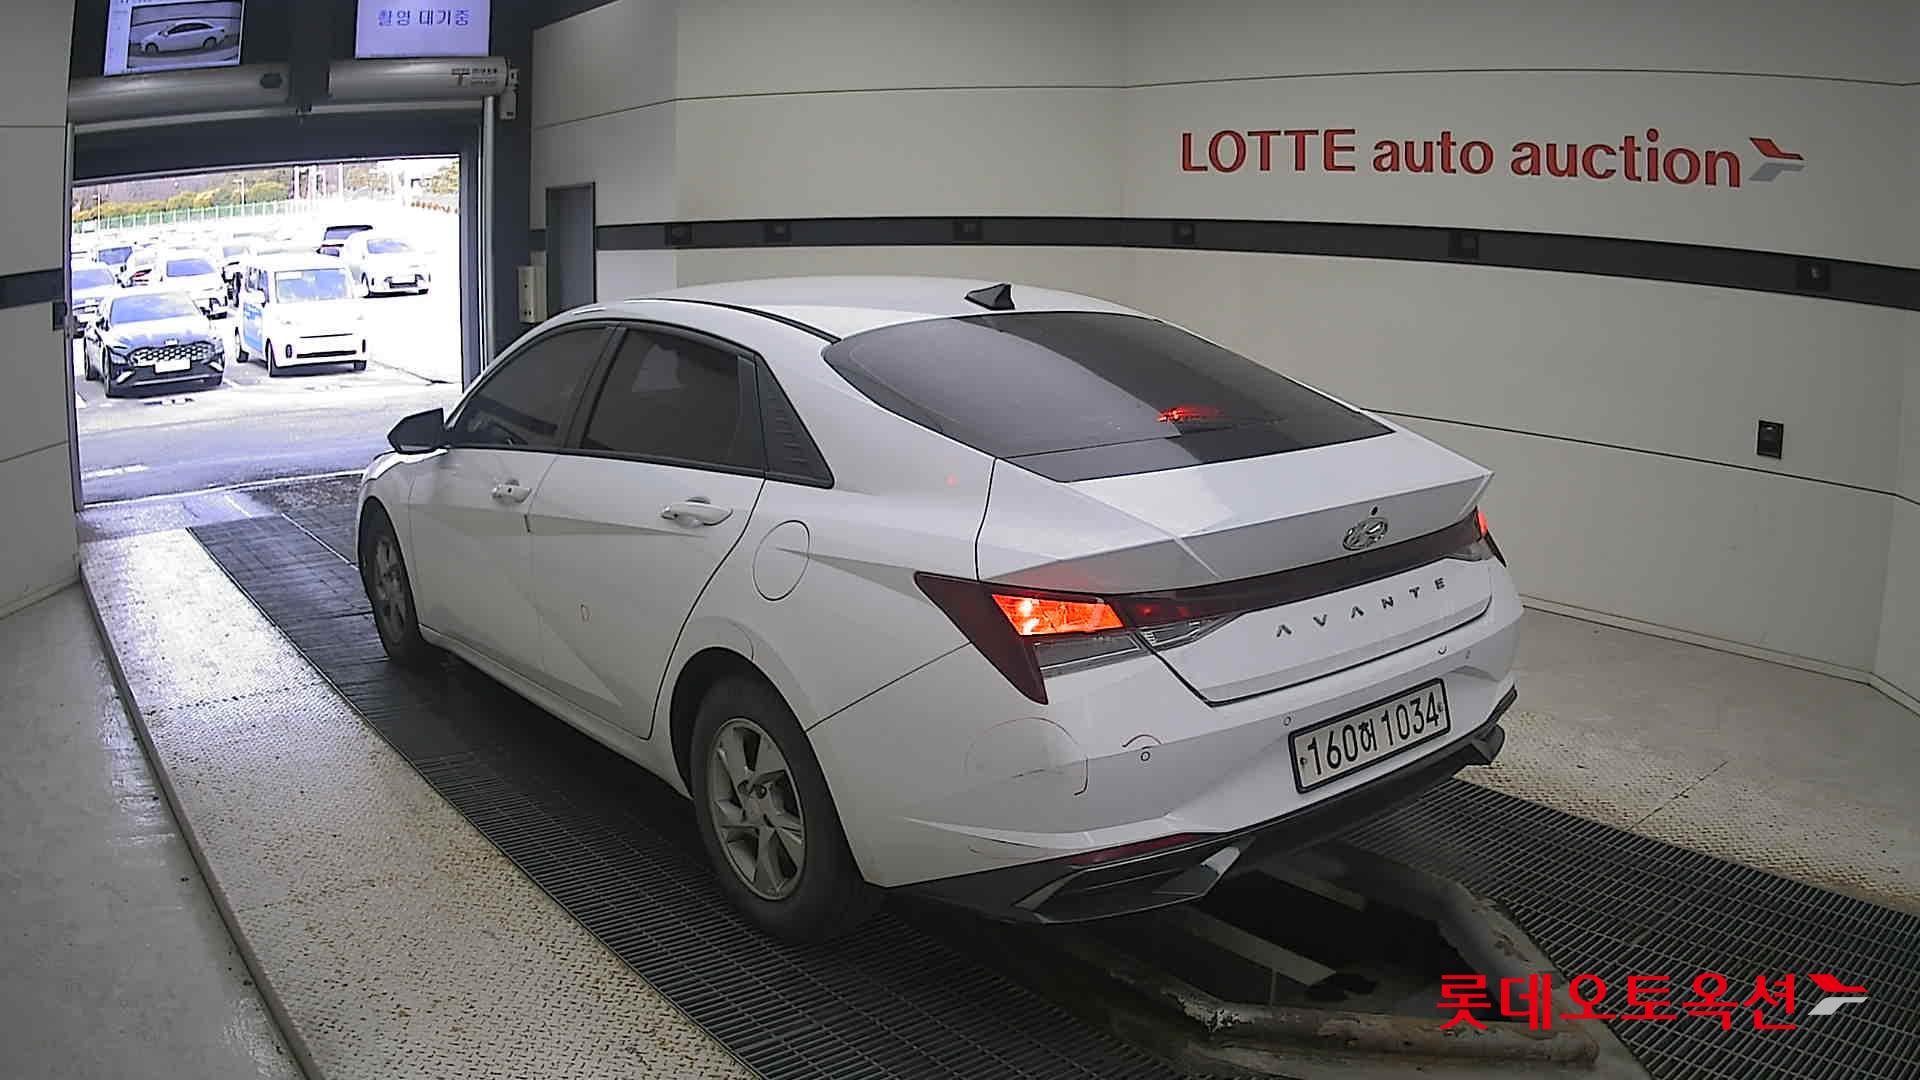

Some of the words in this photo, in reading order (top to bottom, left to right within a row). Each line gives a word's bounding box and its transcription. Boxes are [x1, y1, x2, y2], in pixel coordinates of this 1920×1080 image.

[1181, 128, 1357, 172] LOTTE
[1372, 131, 1496, 174] auto
[1510, 128, 1742, 188] auction
[1275, 577, 1447, 638] AVANTE
[1381, 691, 1440, 746] 1034
